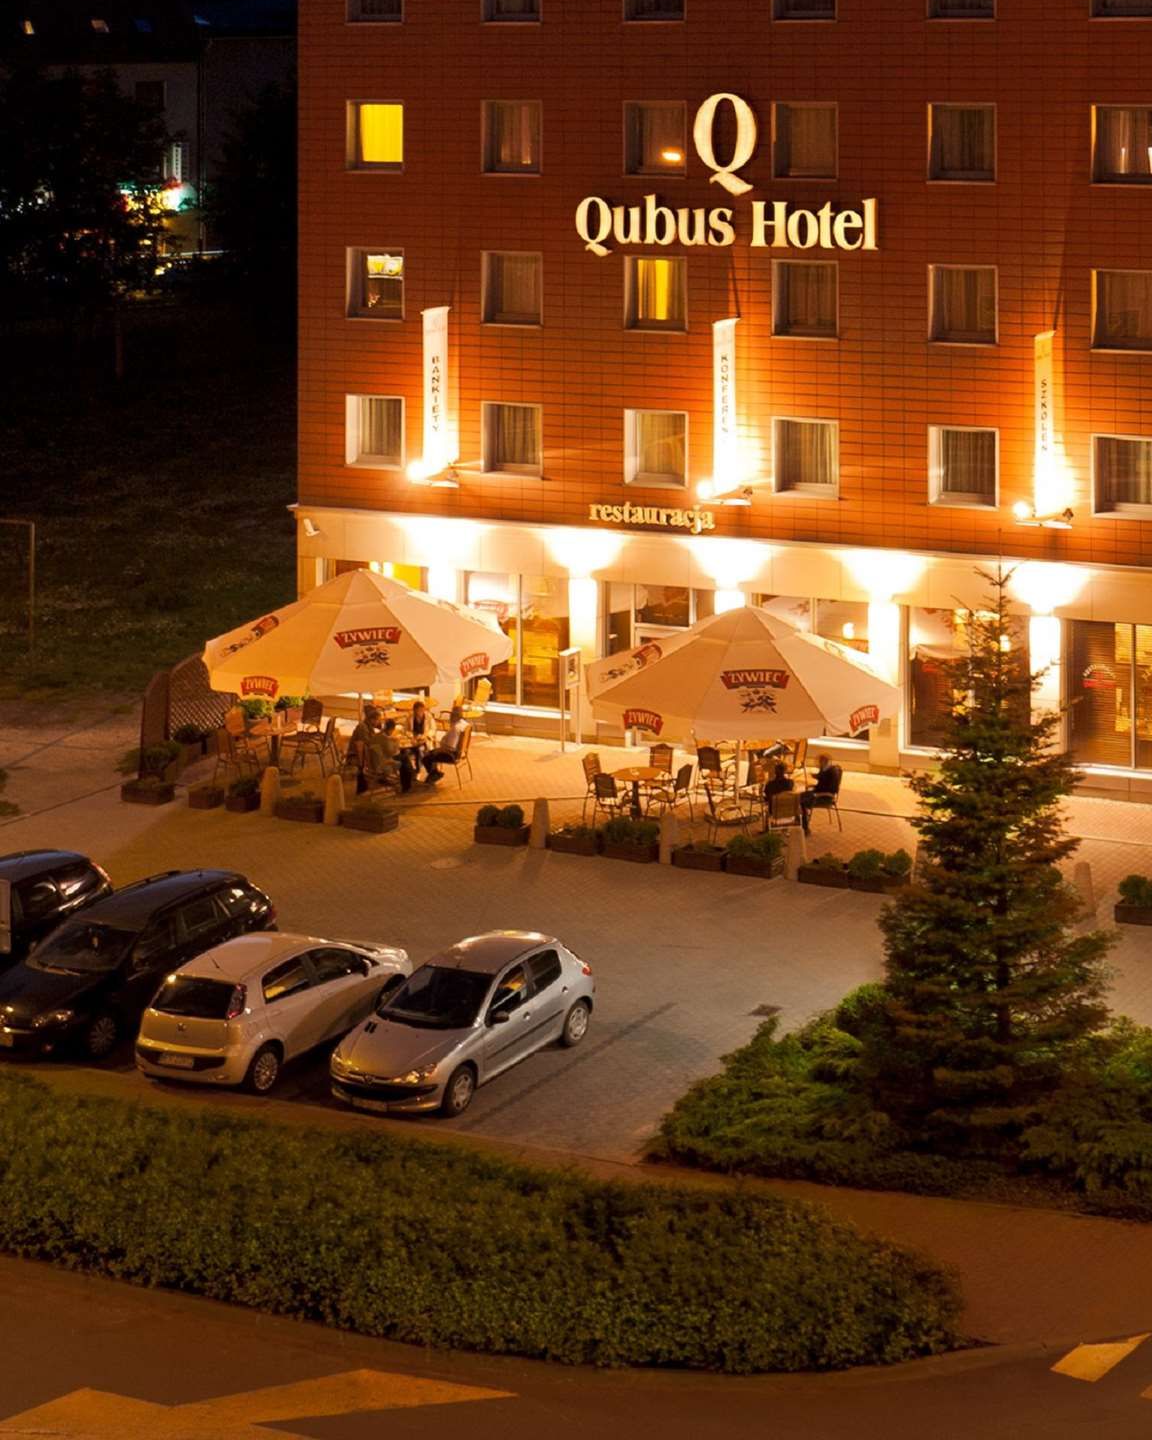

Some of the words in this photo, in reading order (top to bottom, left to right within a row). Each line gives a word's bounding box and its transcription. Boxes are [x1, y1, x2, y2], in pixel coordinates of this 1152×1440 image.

[692, 92, 758, 196] Q
[575, 194, 736, 257] Qubus
[750, 198, 879, 251] Hotel
[431, 355, 441, 433] BANKIETY
[588, 501, 715, 535] restauracja
